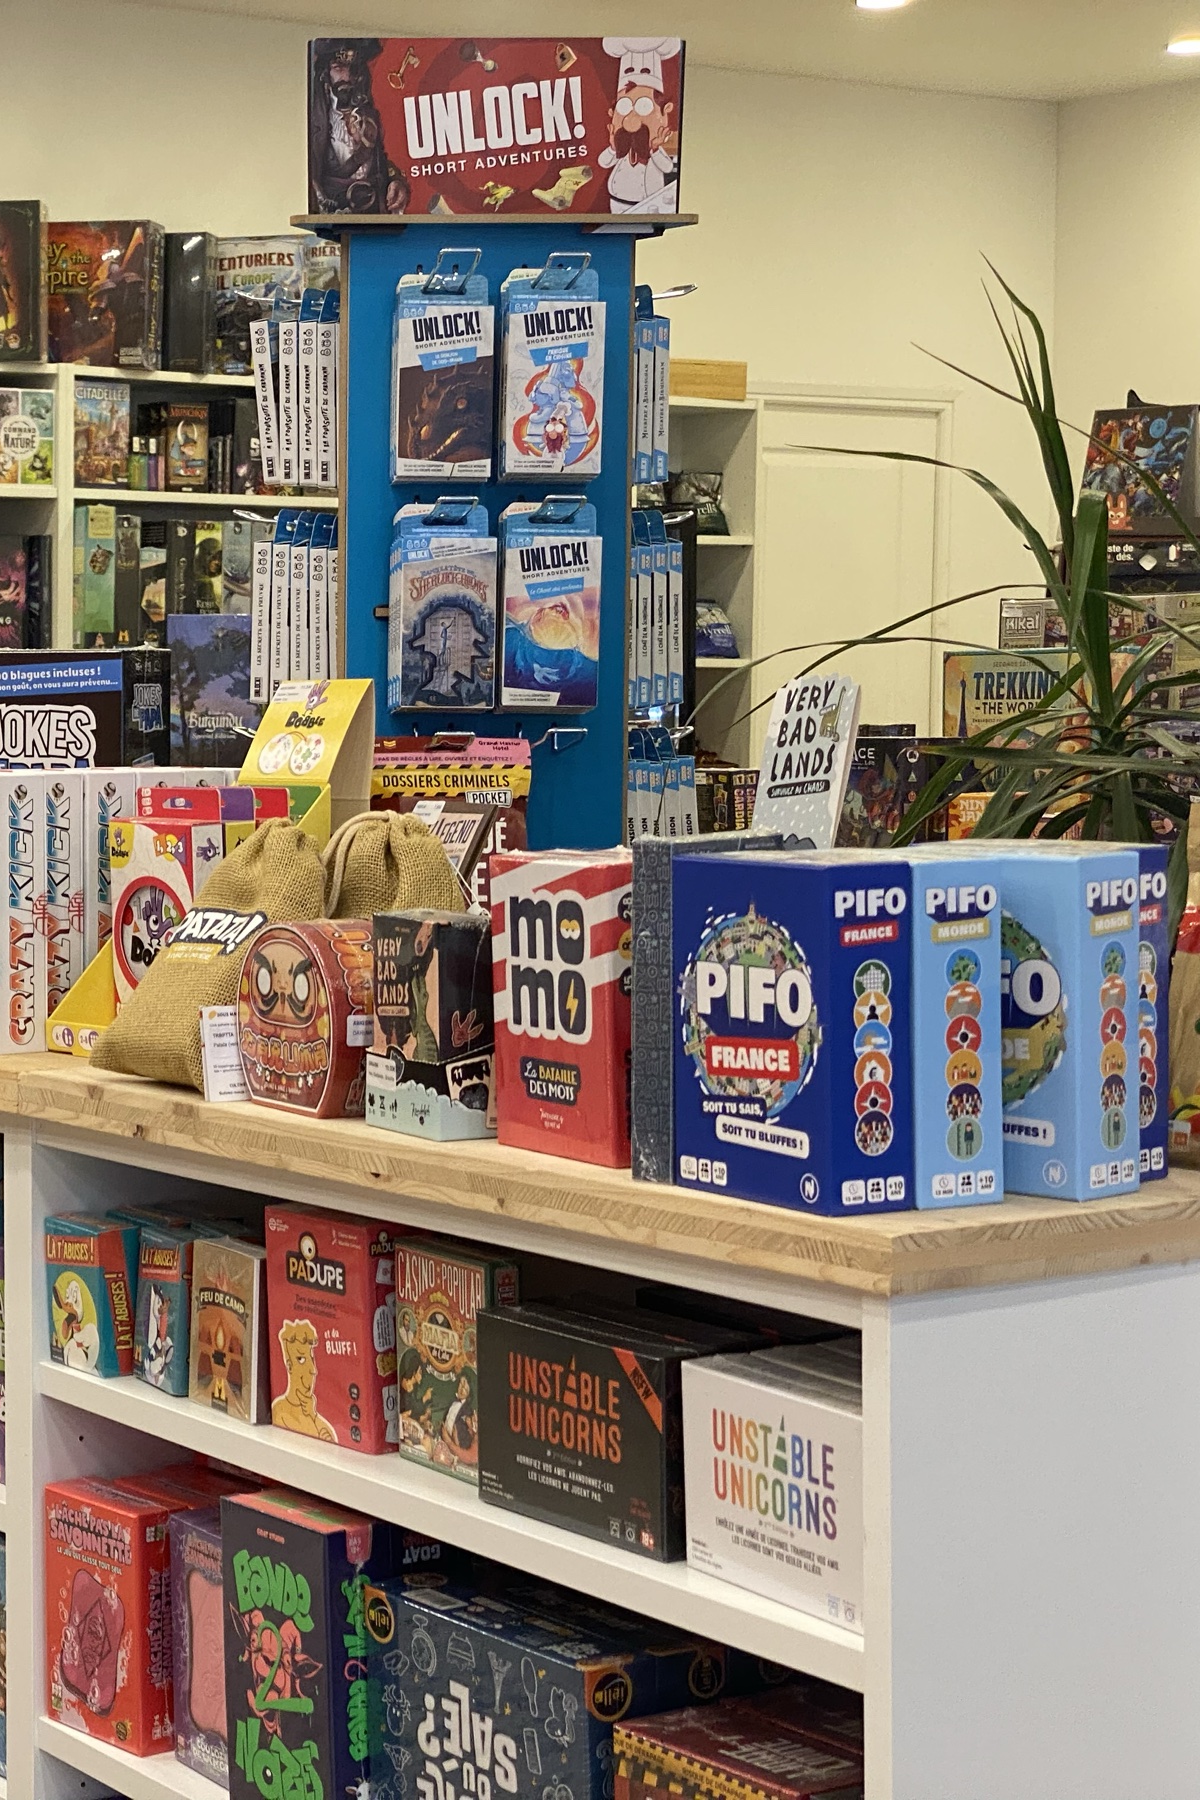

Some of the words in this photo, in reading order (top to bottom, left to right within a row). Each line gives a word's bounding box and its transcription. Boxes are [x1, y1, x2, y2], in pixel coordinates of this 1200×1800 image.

[403, 77, 587, 159] UNLOCK!
[410, 160, 467, 177] SHORT
[475, 145, 588, 170] ADVENTURES
[71, 253, 90, 264] the
[233, 272, 276, 287] EUROPE
[412, 311, 482, 342] UNLOCK!
[524, 306, 593, 338] UNLOCK!
[439, 336, 483, 347] ADVENTURES
[551, 332, 594, 342] ADVENTURES
[75, 385, 128, 401] CITADELLES
[3, 426, 37, 434] COMMAND
[3, 435, 37, 449] NATURE
[520, 542, 589, 572] UNLOCK!
[1123, 544, 1133, 552] de
[522, 572, 544, 580] SHORT
[547, 567, 590, 577] ADVENTURES
[10, 670, 50, 680] blagues
[53, 668, 95, 678] incluses
[12, 682, 31, 692] goût,
[80, 679, 118, 688] prévenu...
[783, 680, 835, 714] VERY
[982, 702, 1003, 715] THE
[284, 710, 326, 728] DOBBLE
[777, 716, 817, 747] BAD
[770, 743, 836, 781] LANDS
[383, 775, 441, 788] DOSSIERS
[444, 775, 509, 788] CRIMINELS
[473, 792, 508, 803] POCKET
[8, 794, 34, 911] KICK
[834, 887, 906, 919] PIFO
[925, 884, 998, 915] PIFO
[1086, 878, 1138, 908] PIFO
[844, 925, 893, 943] FRANCE
[937, 922, 985, 938] MONDE
[1095, 915, 1131, 931] MONDE
[377, 936, 402, 960] VERY
[8, 916, 36, 1045] CRAZY
[377, 960, 398, 982] BAD
[377, 982, 409, 1005] LANDS
[696, 960, 813, 1028] PIFO
[711, 1045, 791, 1072] FRANCE
[523, 1060, 538, 1080] La
[538, 1066, 578, 1087] BATAILLE
[529, 1078, 550, 1097] DES
[550, 1081, 574, 1101] MOTS
[702, 1100, 724, 1114] SOIT
[725, 1101, 736, 1114] TU
[736, 1102, 764, 1117] SAIS,
[721, 1122, 742, 1137] SOIT
[744, 1126, 756, 1140] TU
[758, 1129, 797, 1150] BLUFFES
[289, 1258, 345, 1290] PADUPE
[398, 1251, 436, 1300] CASINO
[441, 1262, 484, 1321] POPULAR
[200, 1292, 213, 1305] FEU
[214, 1293, 223, 1307] DE
[223, 1295, 245, 1314] CAMP
[331, 1329, 339, 1339] du
[508, 1351, 621, 1420] UNSTABLE
[629, 1369, 651, 1400] NSFW
[509, 1394, 622, 1464] UNICORNS
[712, 1408, 834, 1491] UNSTABLE
[713, 1456, 838, 1541] UNICORNS
[49, 1518, 132, 1566] SAVONNETTE
[255, 1620, 314, 1714] 2
